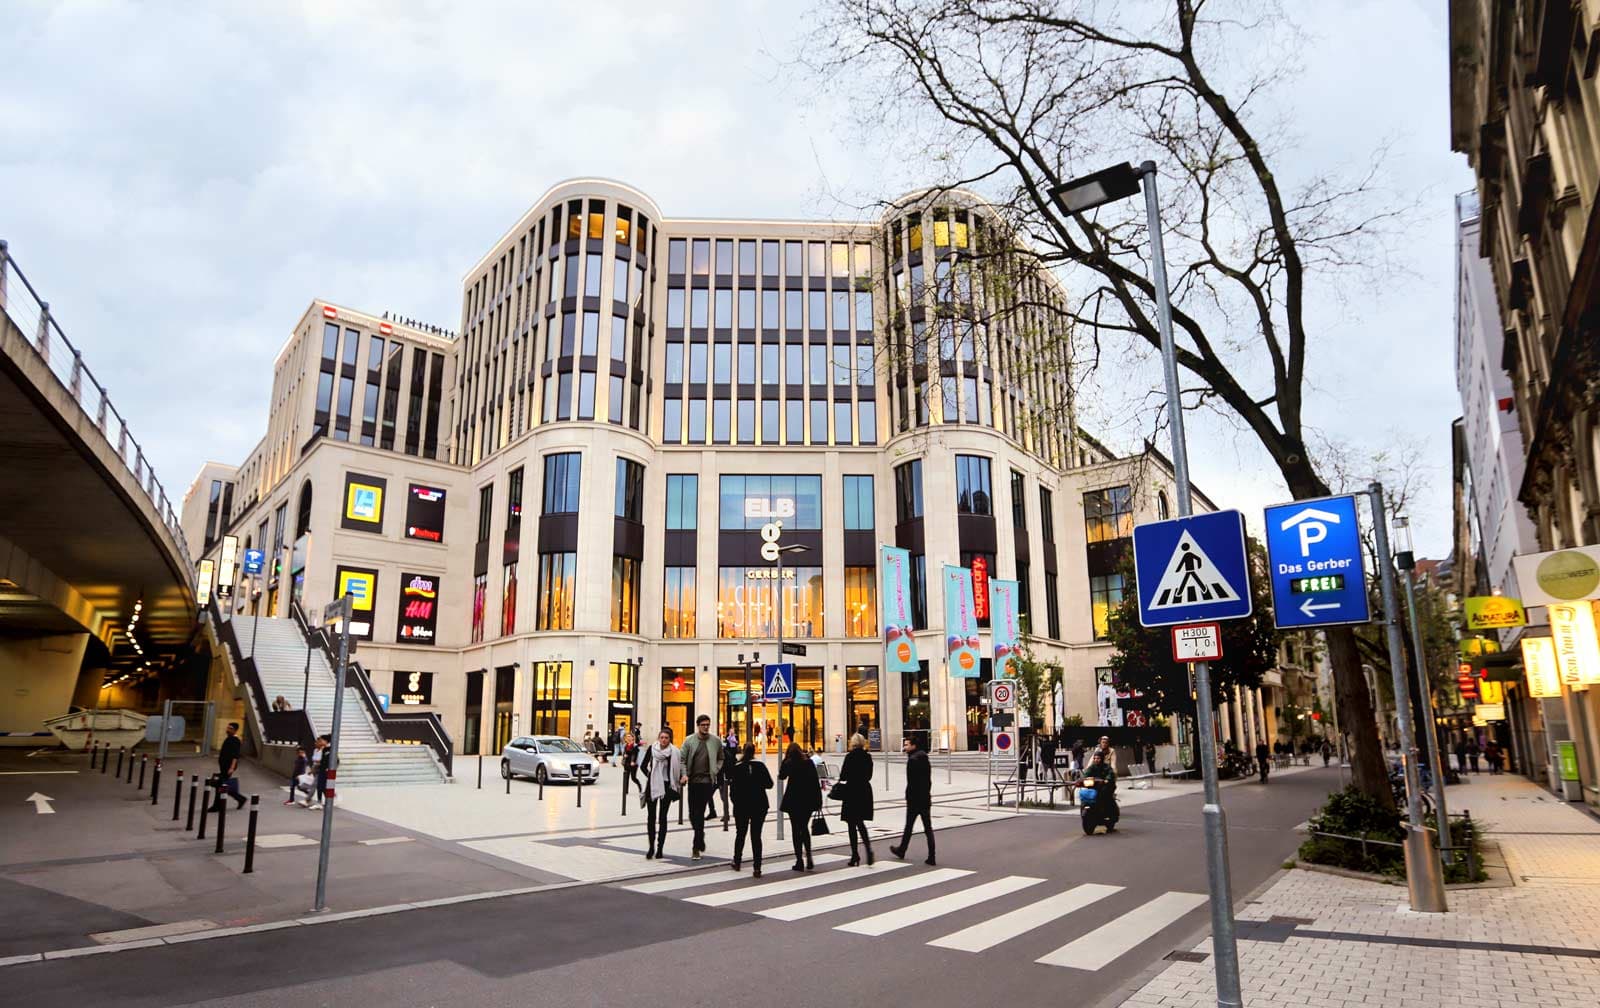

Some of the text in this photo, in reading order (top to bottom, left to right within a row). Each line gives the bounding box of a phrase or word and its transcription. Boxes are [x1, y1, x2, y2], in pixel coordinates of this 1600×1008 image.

[745, 498, 795, 518] ELB
[1298, 521, 1328, 557] P
[1278, 558, 1352, 575] Das Gerber
[409, 576, 433, 591] dm
[1300, 576, 1337, 592] FREI
[998, 690, 1006, 698] 20
